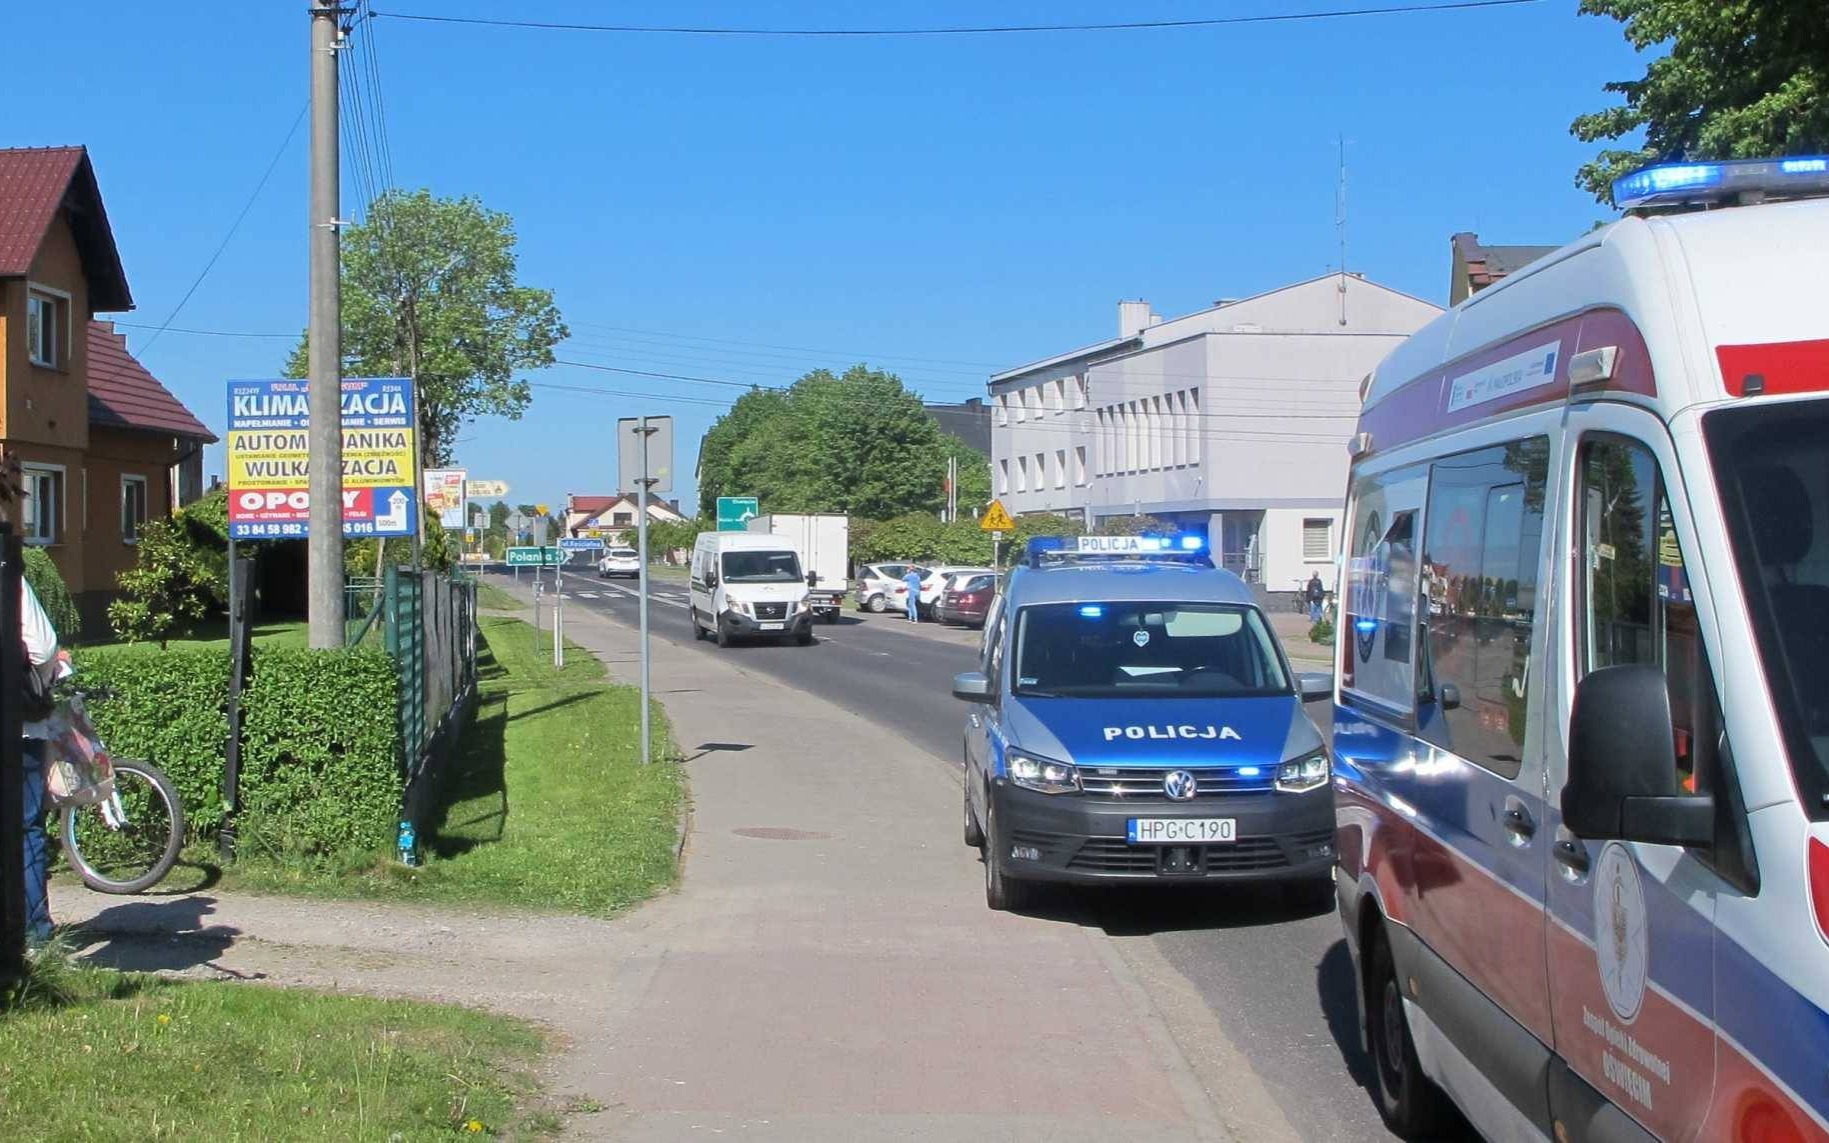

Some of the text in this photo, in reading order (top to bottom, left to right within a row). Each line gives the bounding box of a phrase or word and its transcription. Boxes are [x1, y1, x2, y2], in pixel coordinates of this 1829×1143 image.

[234, 394, 407, 416] KLIMAZACJA
[240, 491, 360, 510] OPOY
[236, 524, 250, 535] 33
[1081, 537, 1139, 551] POLICJA
[1103, 725, 1242, 741] POLICJA
